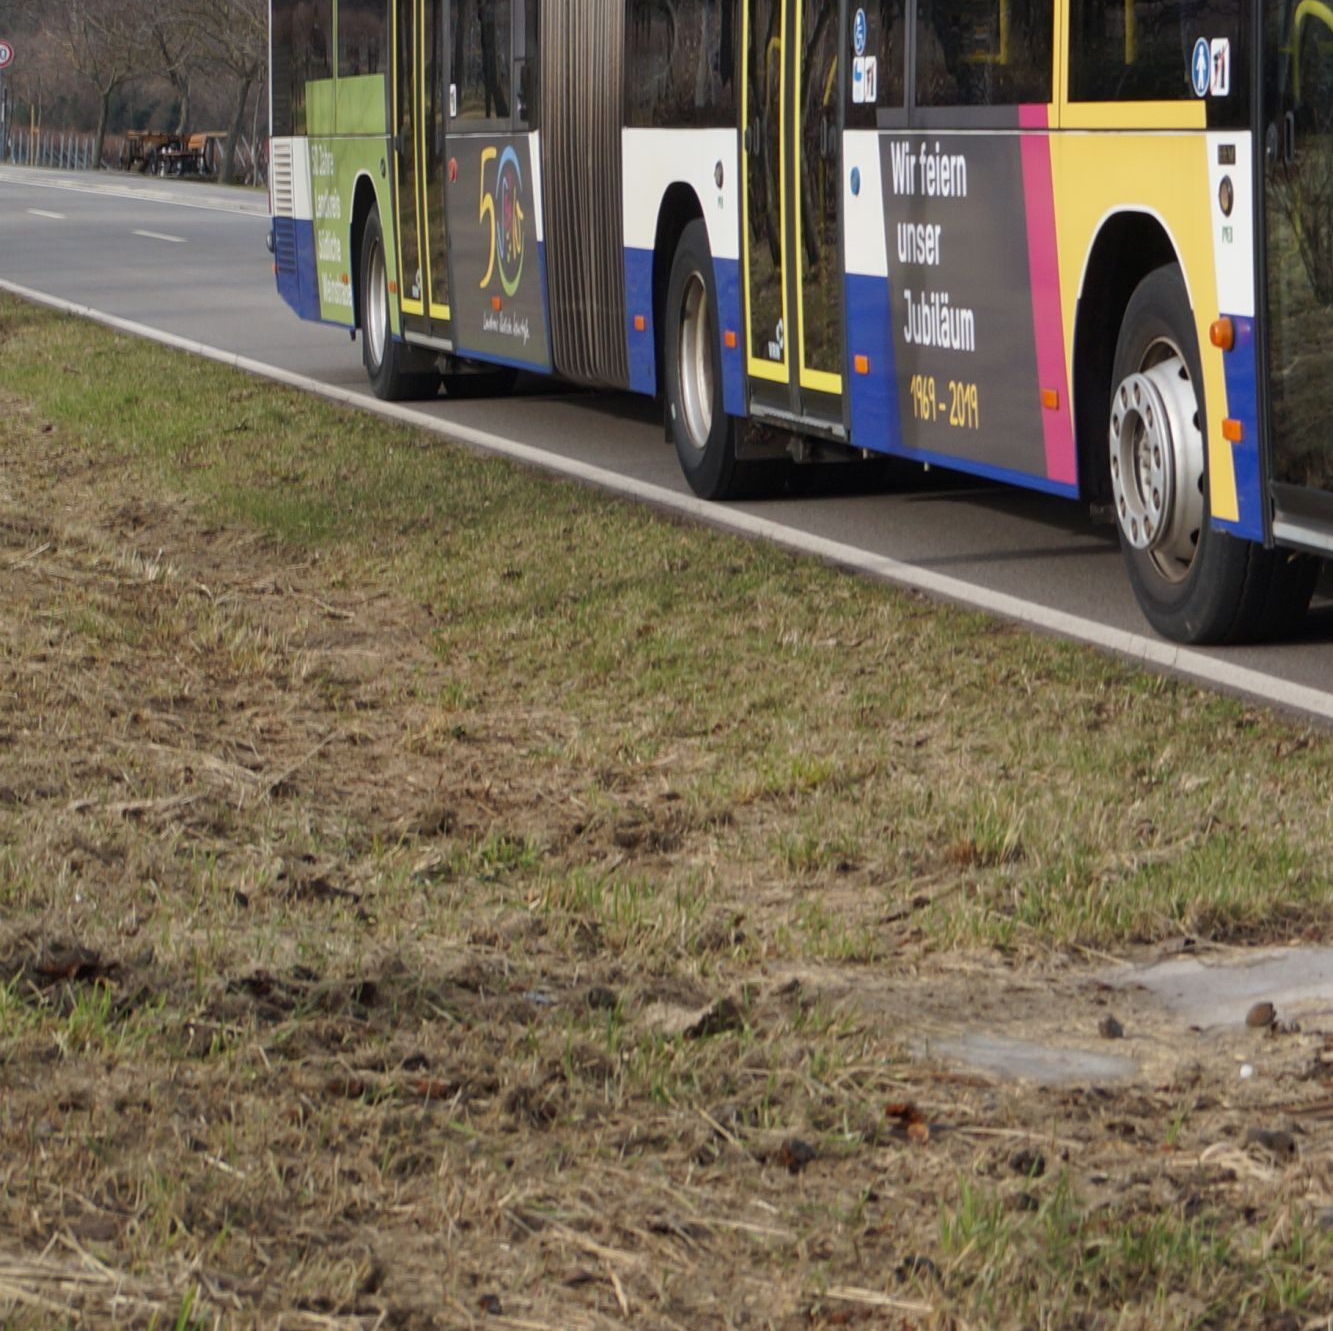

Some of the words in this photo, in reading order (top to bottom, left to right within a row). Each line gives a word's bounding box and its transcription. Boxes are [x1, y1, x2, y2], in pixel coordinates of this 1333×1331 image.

[890, 141, 917, 196] Wir
[919, 141, 968, 197] feiern
[897, 222, 941, 266] unser
[904, 288, 976, 352] Jubiläum
[910, 374, 937, 421] 1969
[948, 380, 979, 431] 2019
